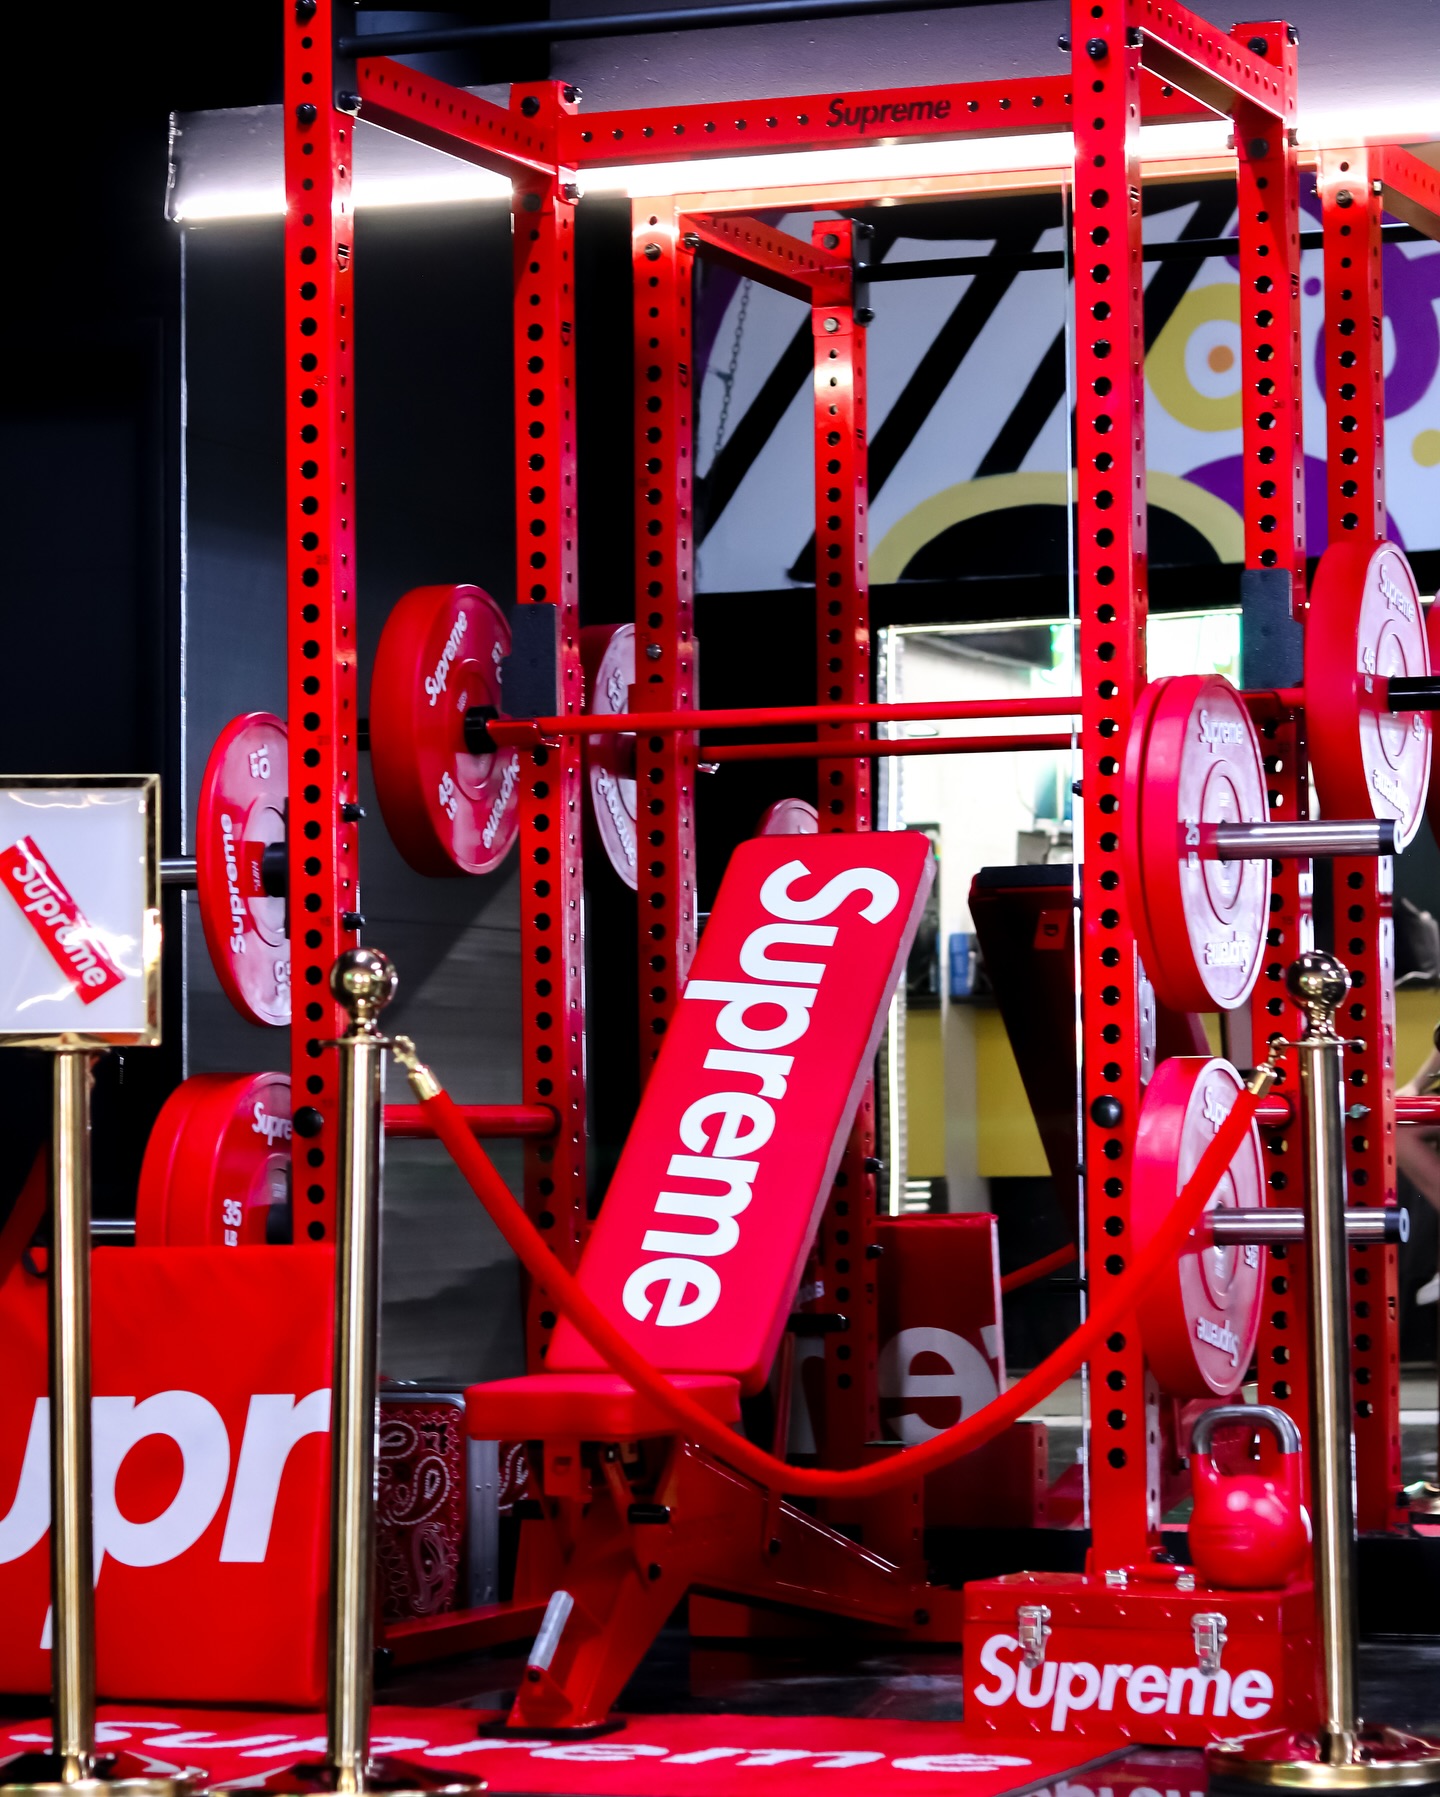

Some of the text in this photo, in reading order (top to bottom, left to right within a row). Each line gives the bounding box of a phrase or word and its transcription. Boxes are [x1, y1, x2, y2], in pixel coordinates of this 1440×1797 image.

[826, 98, 951, 133] Supreme
[424, 610, 468, 707] Supreme
[1198, 709, 1243, 753] Supreme
[220, 813, 247, 954] Supreme
[622, 859, 900, 1328] Supreme
[222, 1198, 243, 1227] 35
[1197, 1316, 1239, 1367] Supreme
[974, 1634, 1274, 1732] Supreme
